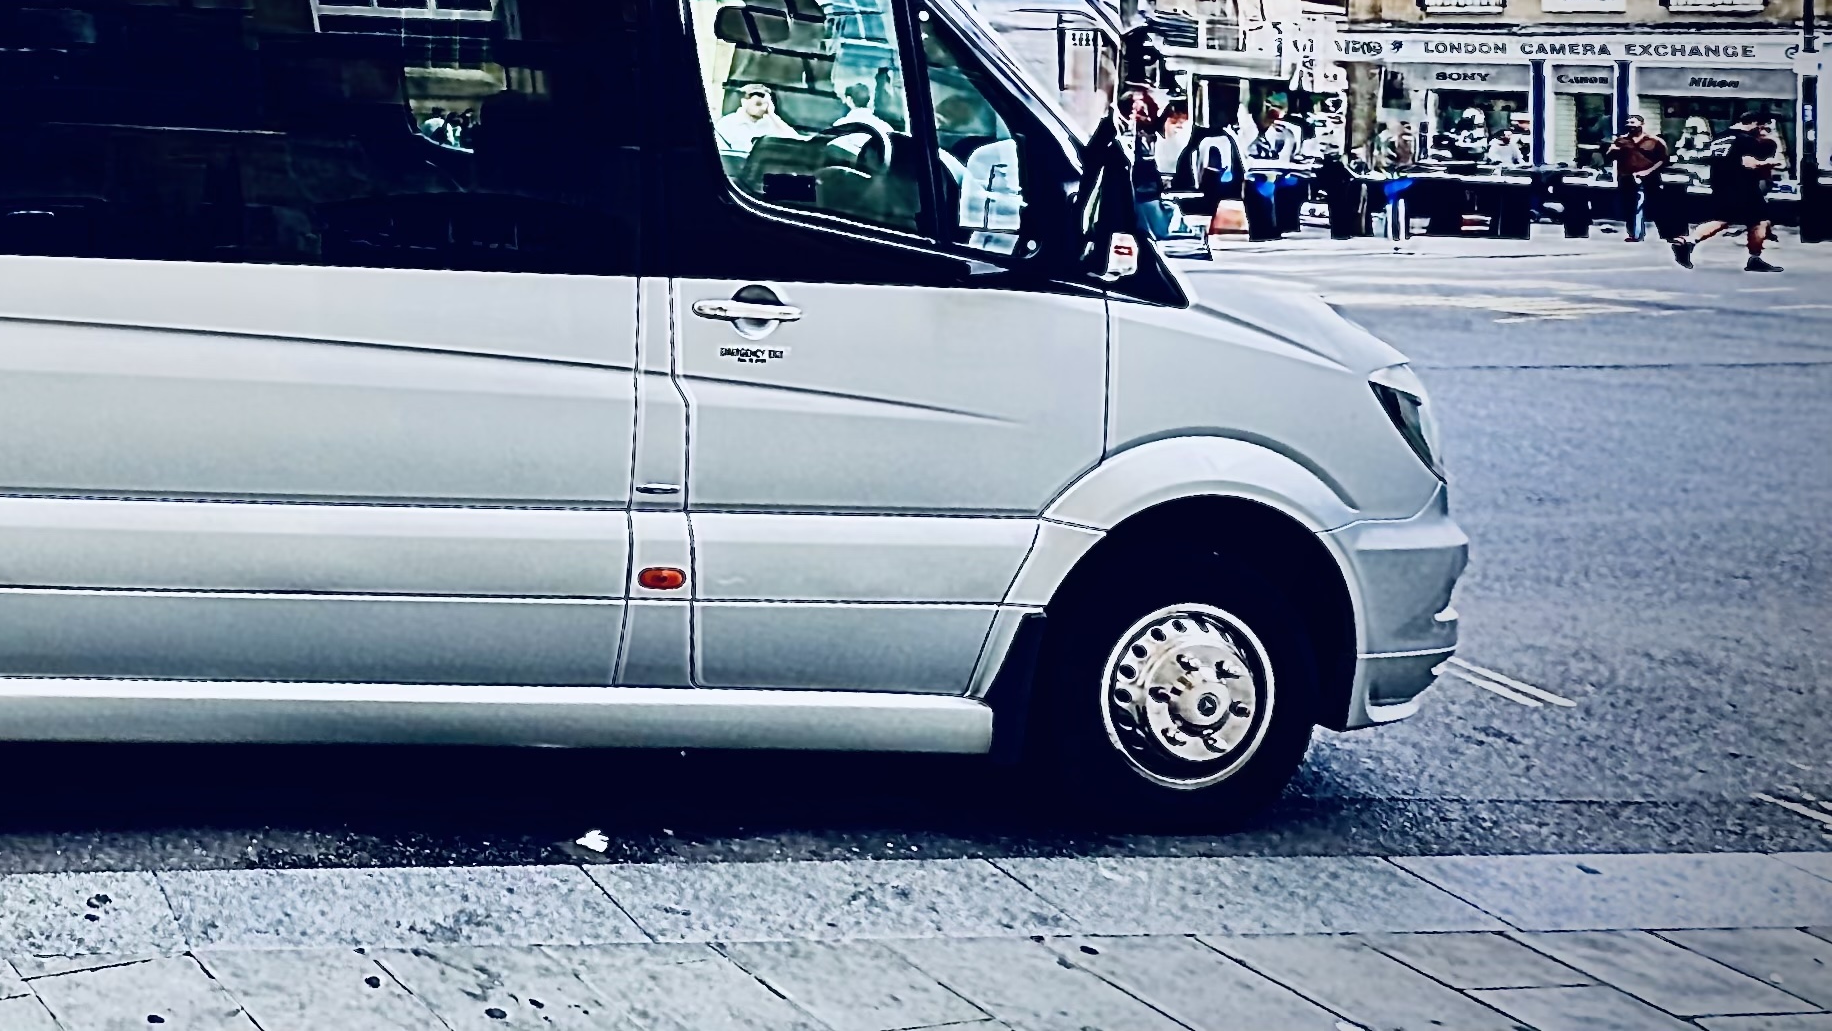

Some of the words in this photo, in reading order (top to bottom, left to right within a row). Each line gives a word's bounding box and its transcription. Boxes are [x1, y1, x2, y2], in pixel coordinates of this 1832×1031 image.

[1423, 41, 1507, 55] LONDON
[1519, 42, 1612, 56] CAMERA
[1624, 43, 1756, 58] EXCHANGE
[1435, 71, 1490, 82] SONY
[1688, 76, 1740, 89] Nikon
